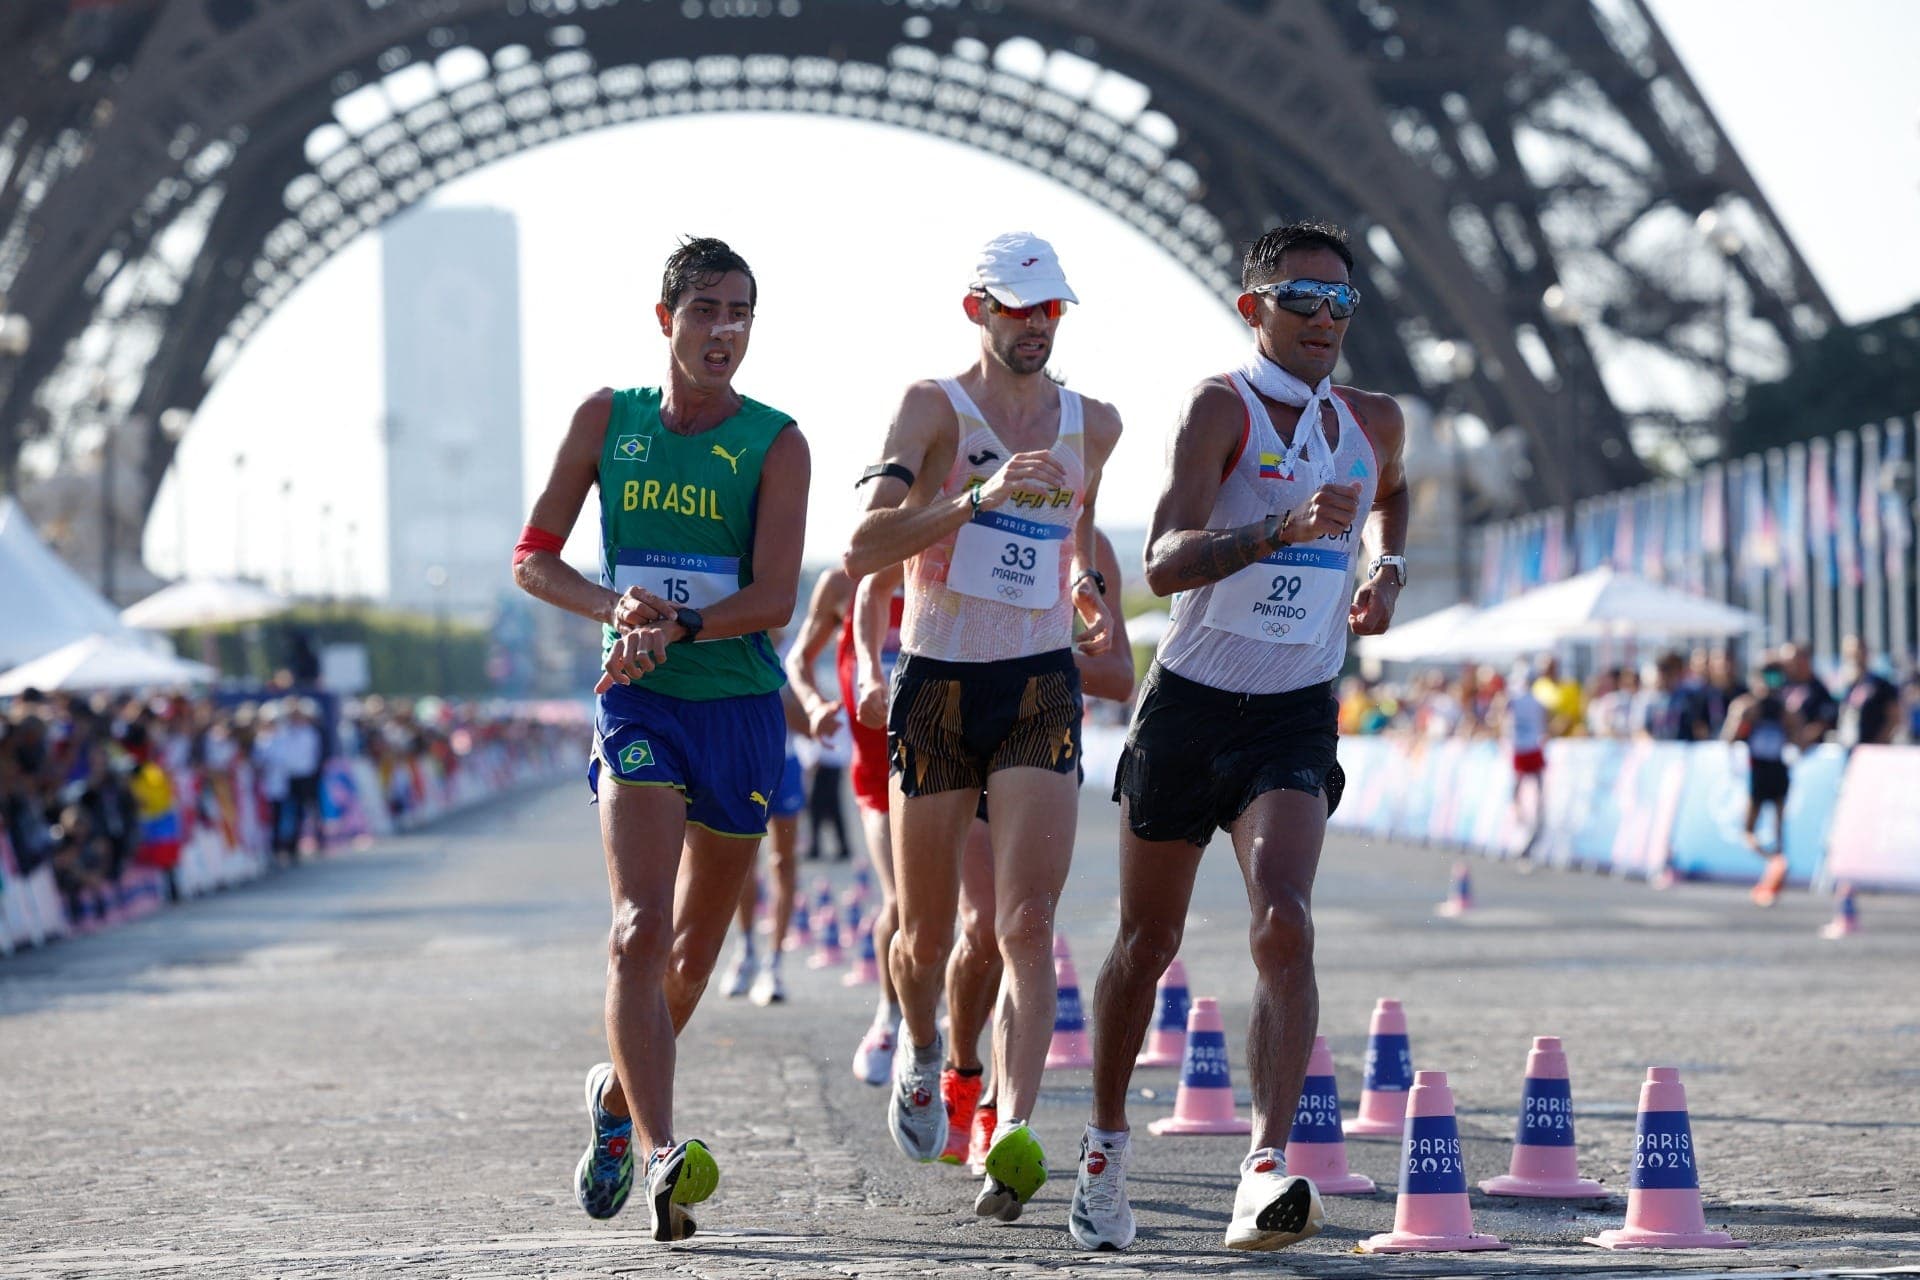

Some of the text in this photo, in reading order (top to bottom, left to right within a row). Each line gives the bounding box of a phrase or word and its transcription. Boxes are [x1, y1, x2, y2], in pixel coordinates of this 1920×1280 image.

[623, 480, 724, 521] BRASIL
[995, 516, 1027, 532] PARIS
[645, 553, 677, 565] PARIS
[1001, 542, 1037, 571] 33
[1270, 551, 1321, 563] ARIS 2024
[991, 566, 1036, 587] MARTIN
[662, 578, 690, 606] 15
[1267, 575, 1302, 602] 29
[1252, 601, 1307, 620] PINTADO
[1298, 1094, 1337, 1110] ARIS
[1525, 1113, 1573, 1129] 2024
[1408, 1157, 1463, 1175] 2024
[1636, 1151, 1691, 1169] 2024
